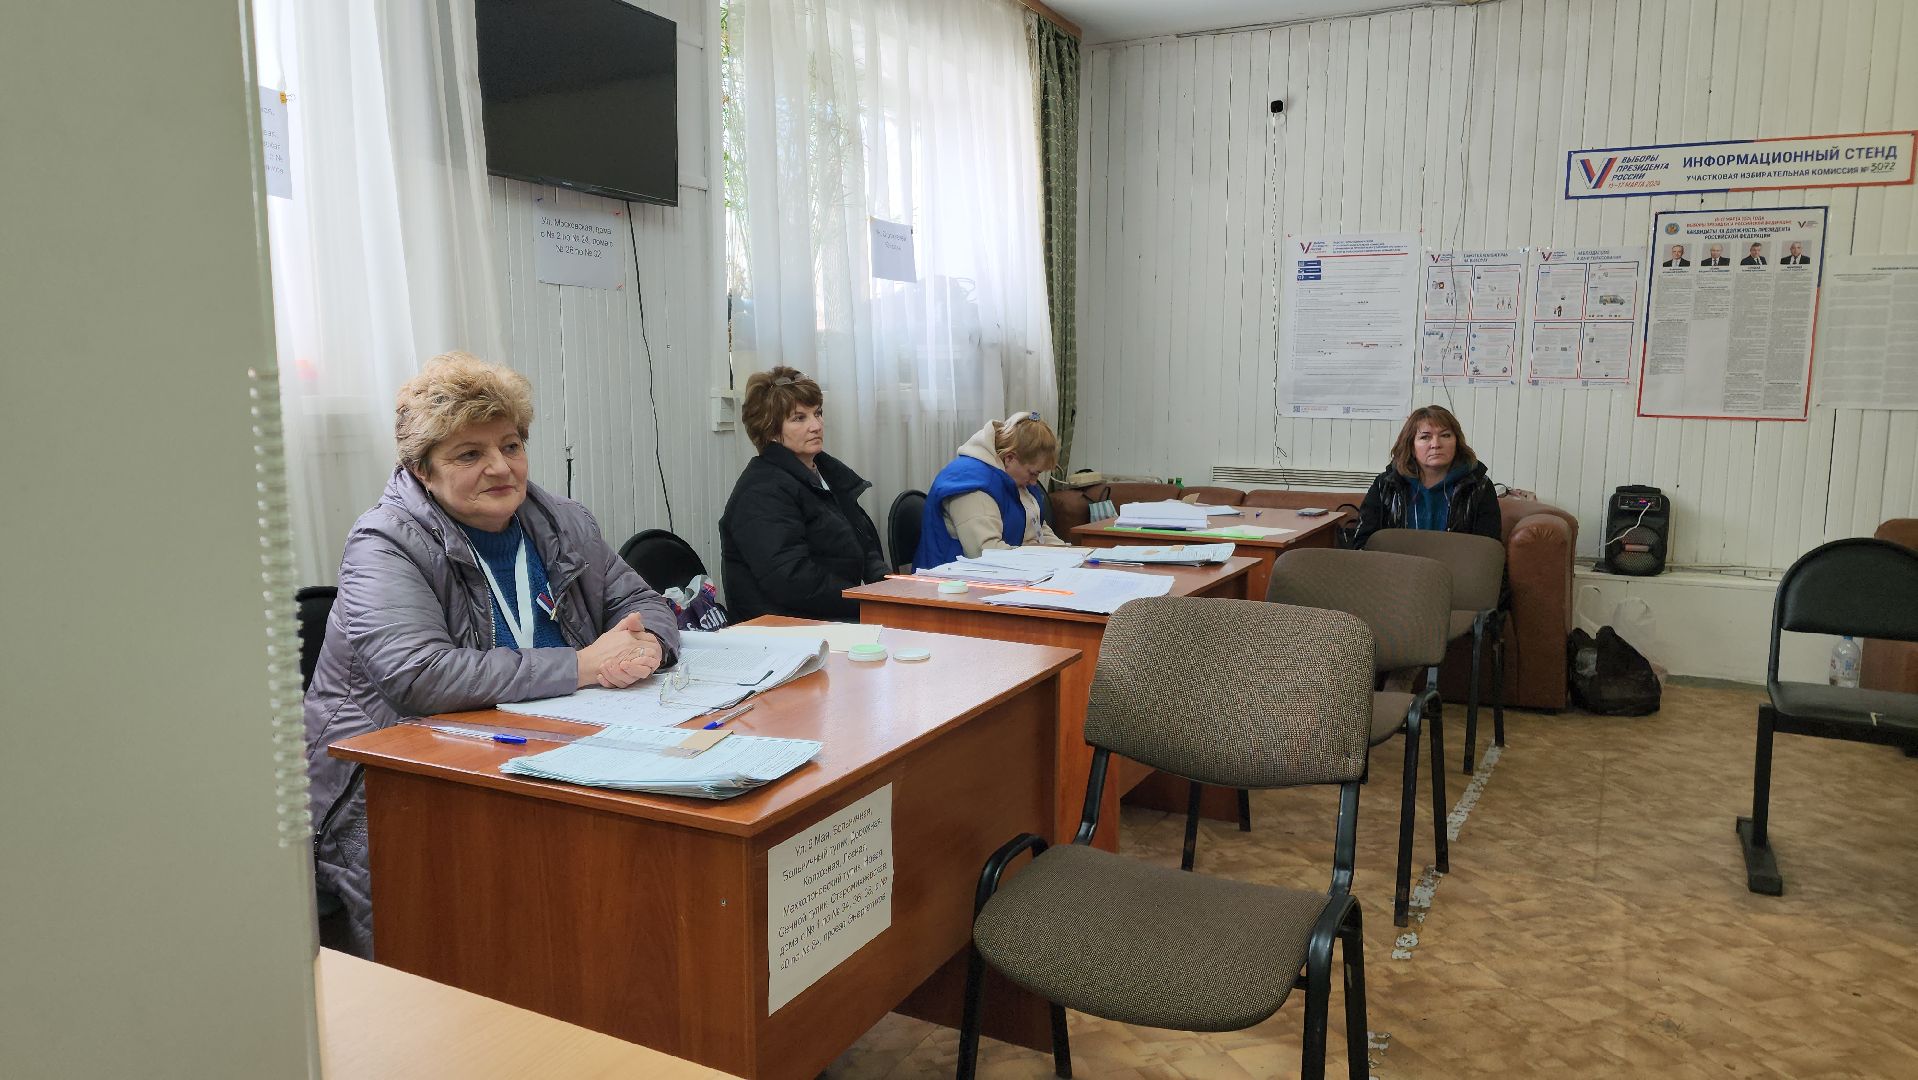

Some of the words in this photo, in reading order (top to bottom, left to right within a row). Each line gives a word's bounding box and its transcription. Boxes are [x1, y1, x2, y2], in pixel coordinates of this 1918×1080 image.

[1621, 154, 1659, 163] ВЫБОРЫ
[1683, 146, 1840, 168] ИНФОРМАЦИОННЫЙ
[1845, 145, 1897, 160] СТЕНД
[1616, 163, 1670, 172] ПРЕЗИДЕНТА
[1686, 173, 1738, 181] УЧАСТКОВАЯ
[1740, 168, 1810, 179] ИЗБИРАТЕЛЬНАЯ
[1811, 166, 1859, 176] КОМИССИЯ
[1611, 172, 1646, 181] РОССИИ
[783, 847, 827, 881] Больничный
